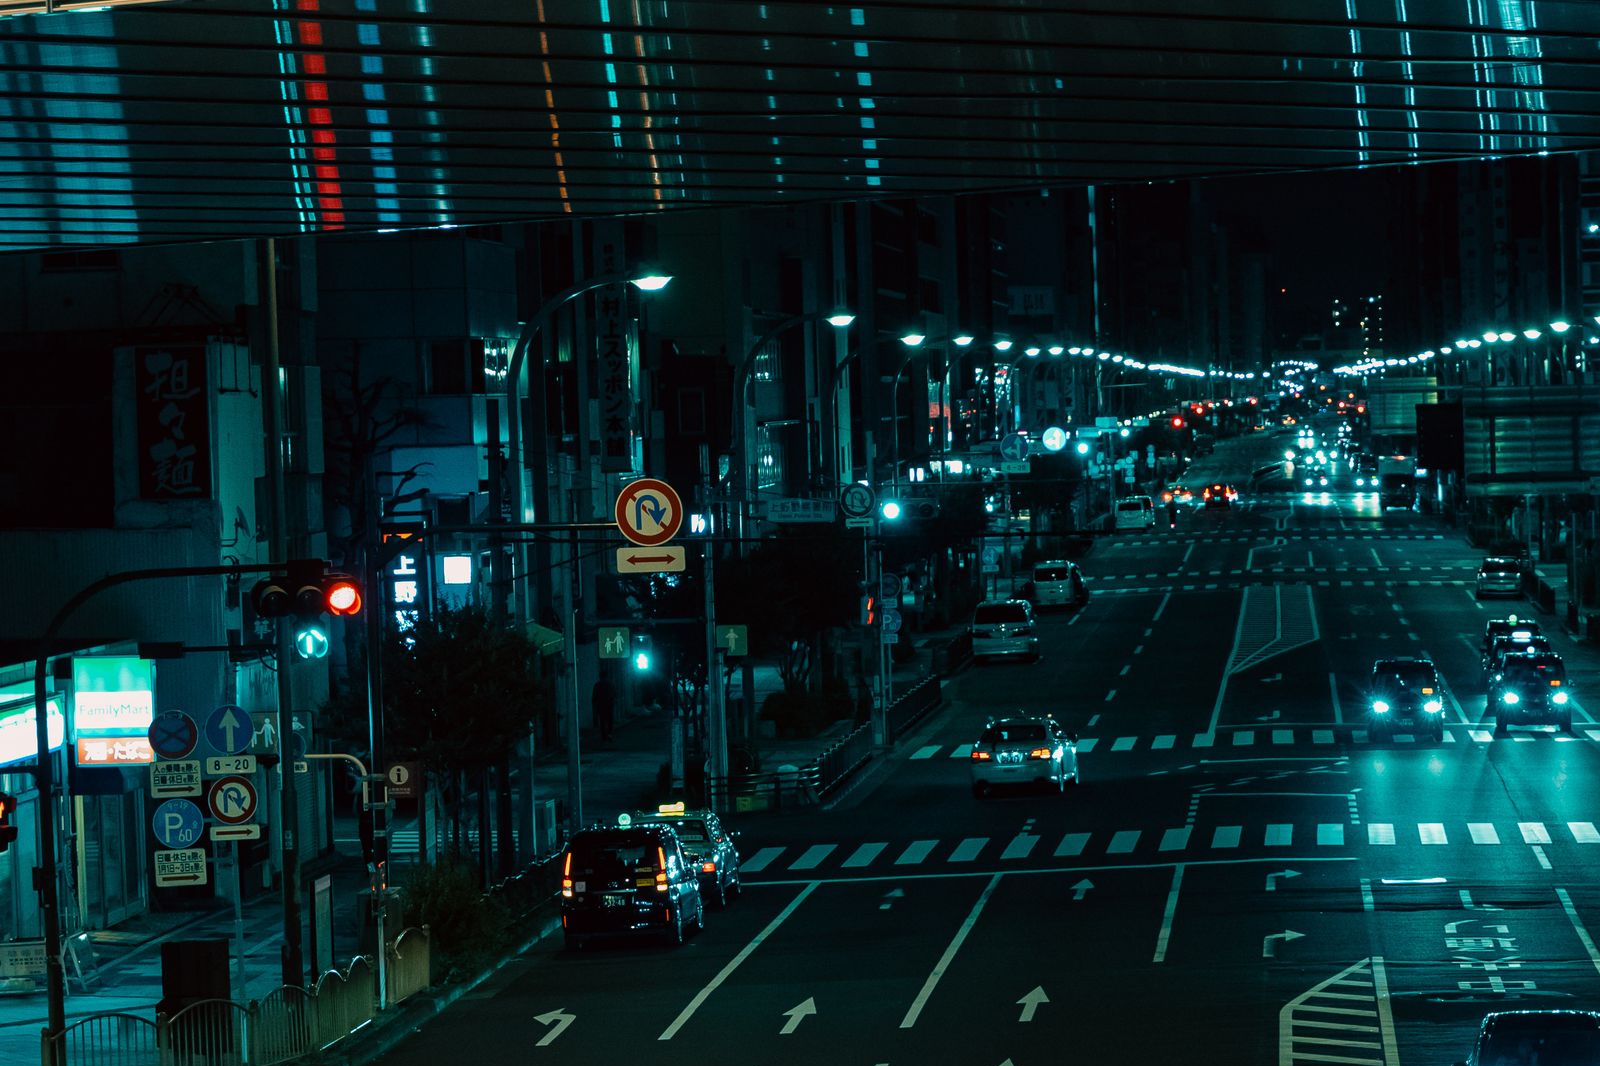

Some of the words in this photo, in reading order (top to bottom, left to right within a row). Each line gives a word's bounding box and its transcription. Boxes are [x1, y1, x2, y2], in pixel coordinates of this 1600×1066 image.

[79, 703, 150, 718] FamilyMart
[165, 812, 183, 844] P
[178, 828, 192, 842] 60
[1444, 920, 1537, 994] 中央通り
